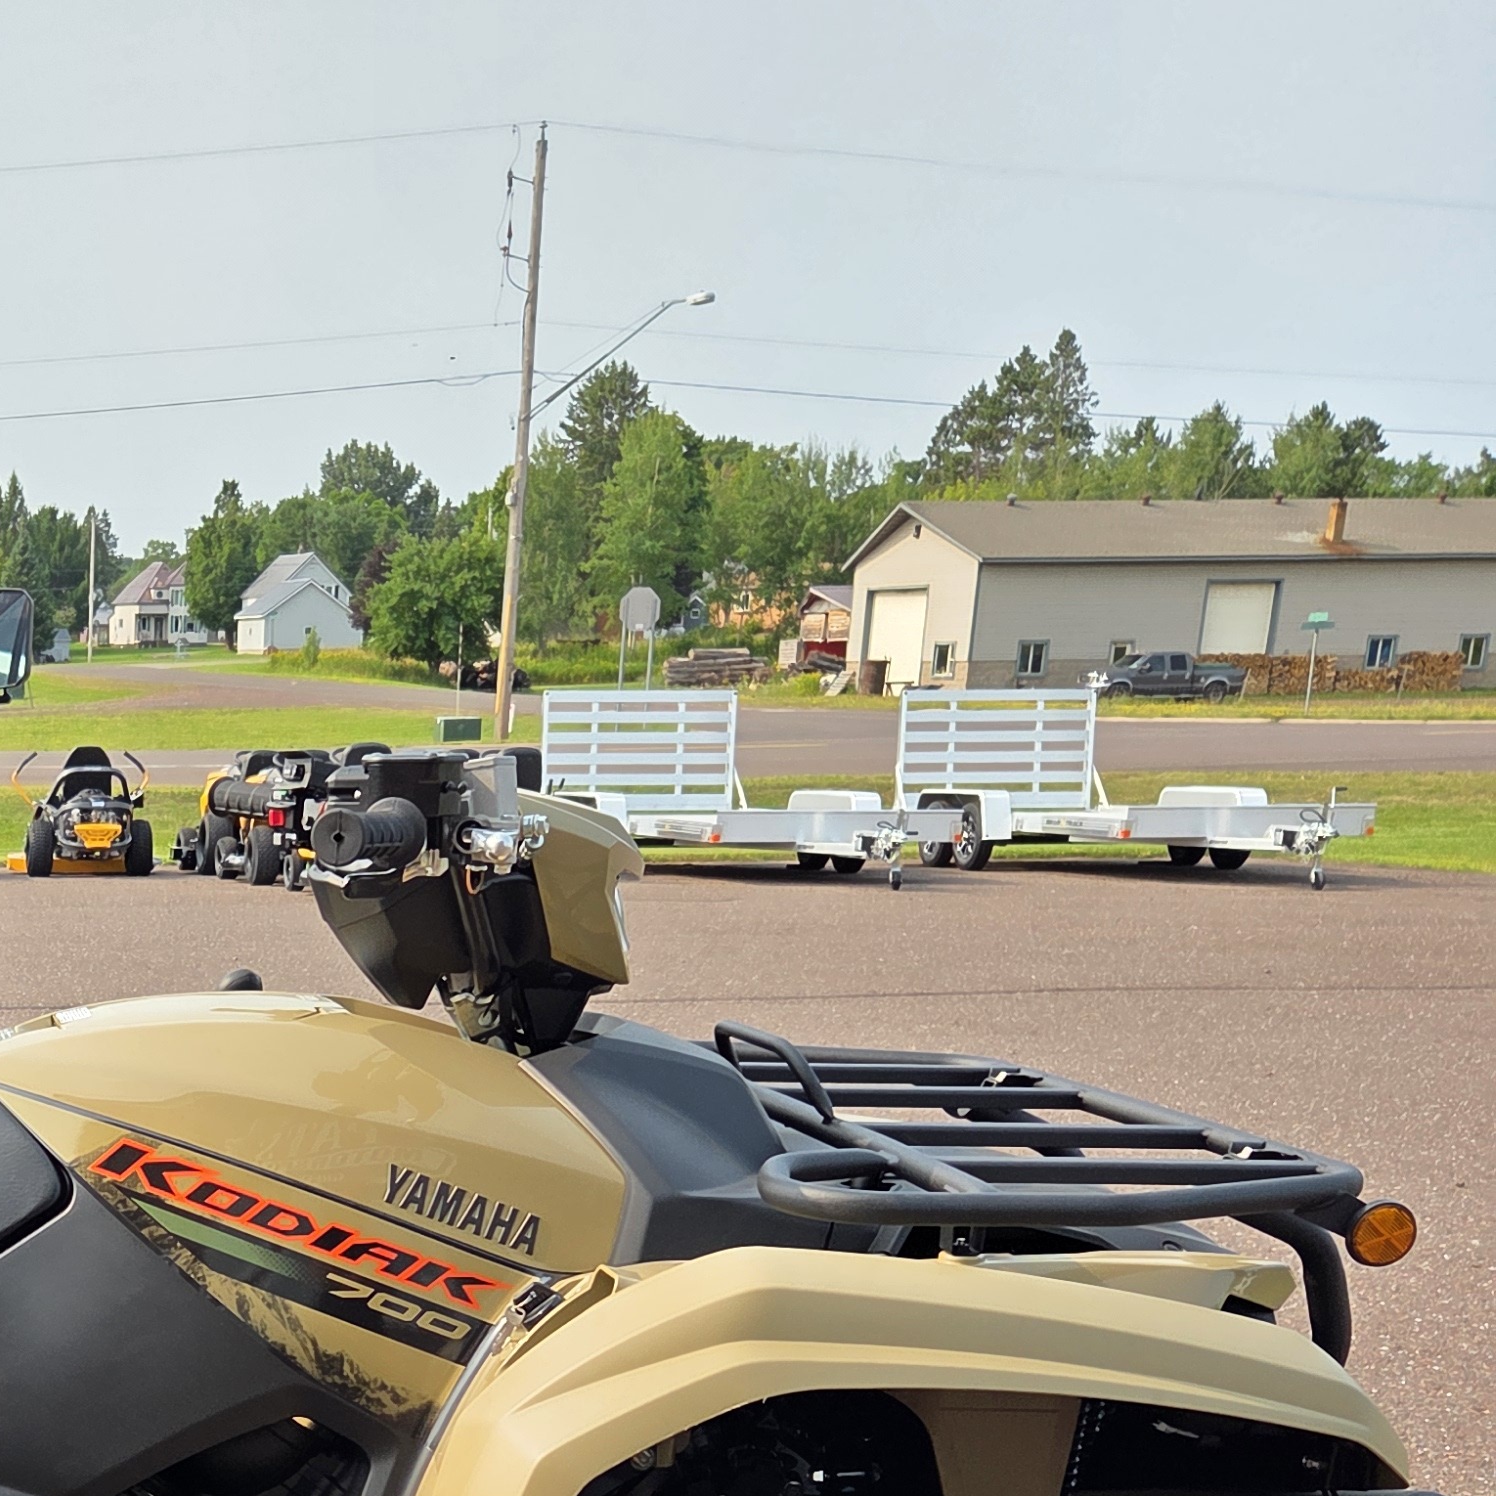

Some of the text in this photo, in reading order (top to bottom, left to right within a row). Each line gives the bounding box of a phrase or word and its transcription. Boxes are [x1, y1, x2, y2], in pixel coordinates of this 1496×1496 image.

[89, 1138, 510, 1312] KODIAK
[383, 1163, 540, 1256] YAMAHA
[325, 1272, 471, 1340] 700
